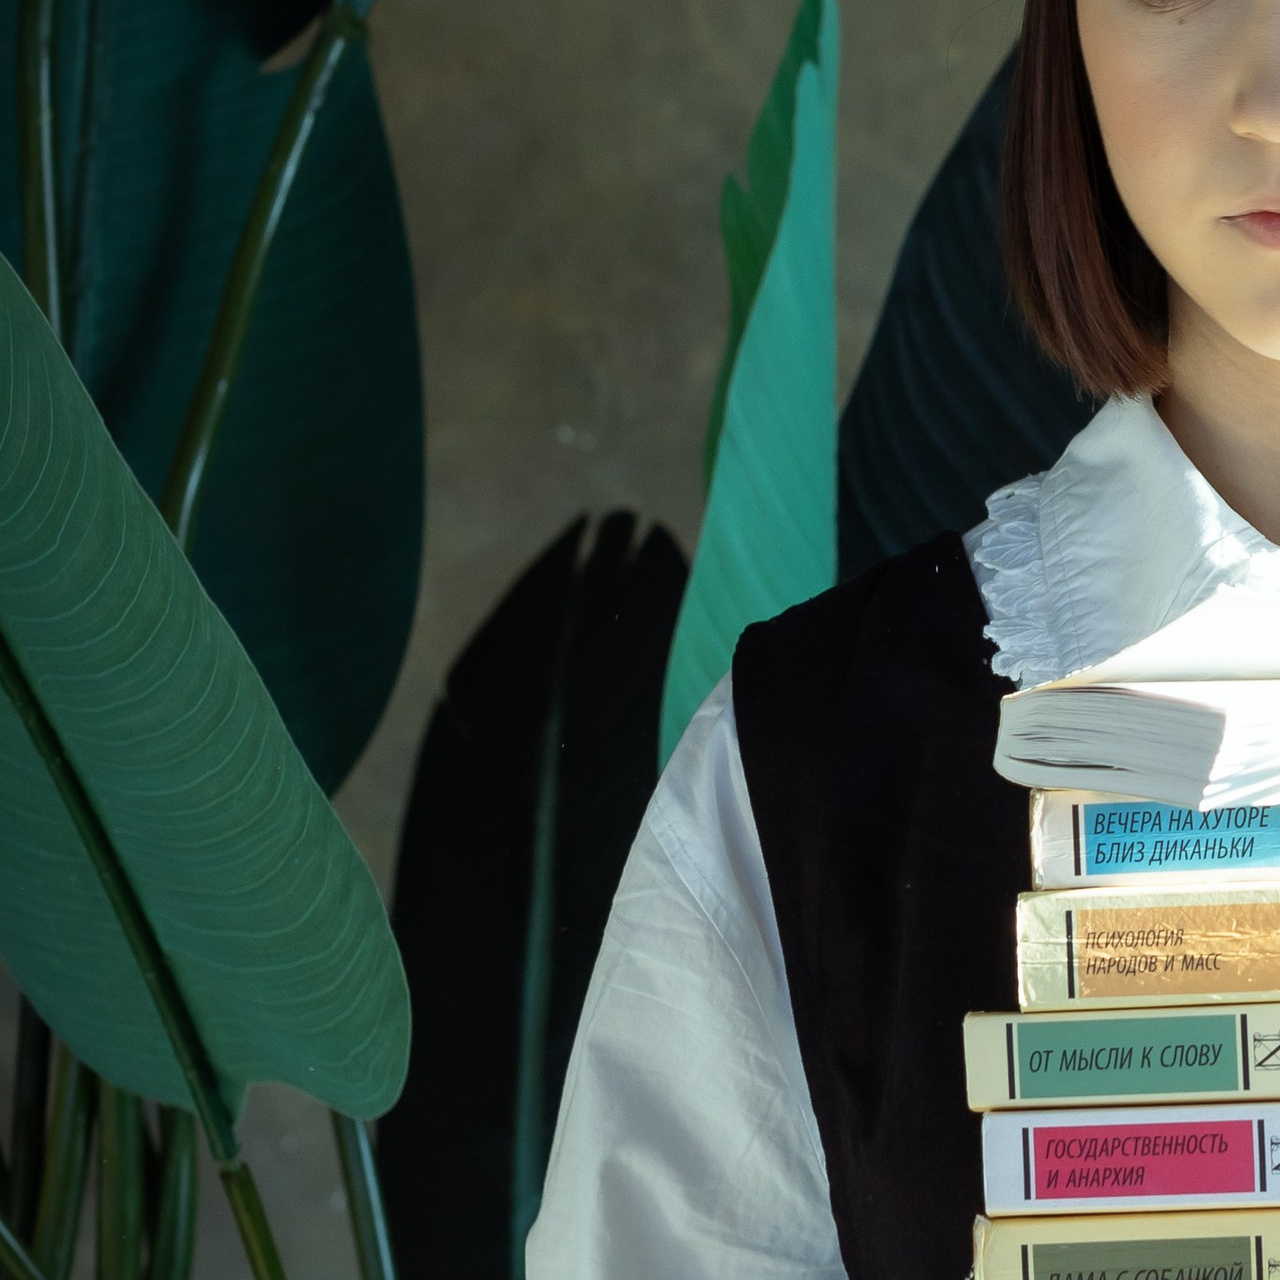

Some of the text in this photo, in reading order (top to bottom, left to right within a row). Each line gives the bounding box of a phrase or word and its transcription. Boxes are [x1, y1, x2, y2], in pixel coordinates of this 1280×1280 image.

[1094, 806, 1270, 834] ВЕЧЕРА НА ХУТОРЕ
[1095, 837, 1255, 865] БЛИЗ ДИКАНЬКИ
[1085, 928, 1184, 949] ПСИХОЛОГИЯ
[1086, 953, 1222, 976] НАРОДОВ И МАСС
[1029, 1043, 1223, 1073] ОТ МЫСЛИ К СЛОВУ
[1045, 1134, 1228, 1161] ГОСУДАРСТВЕННОСТЬ
[1046, 1166, 1145, 1189] И АНАРХИЯ
